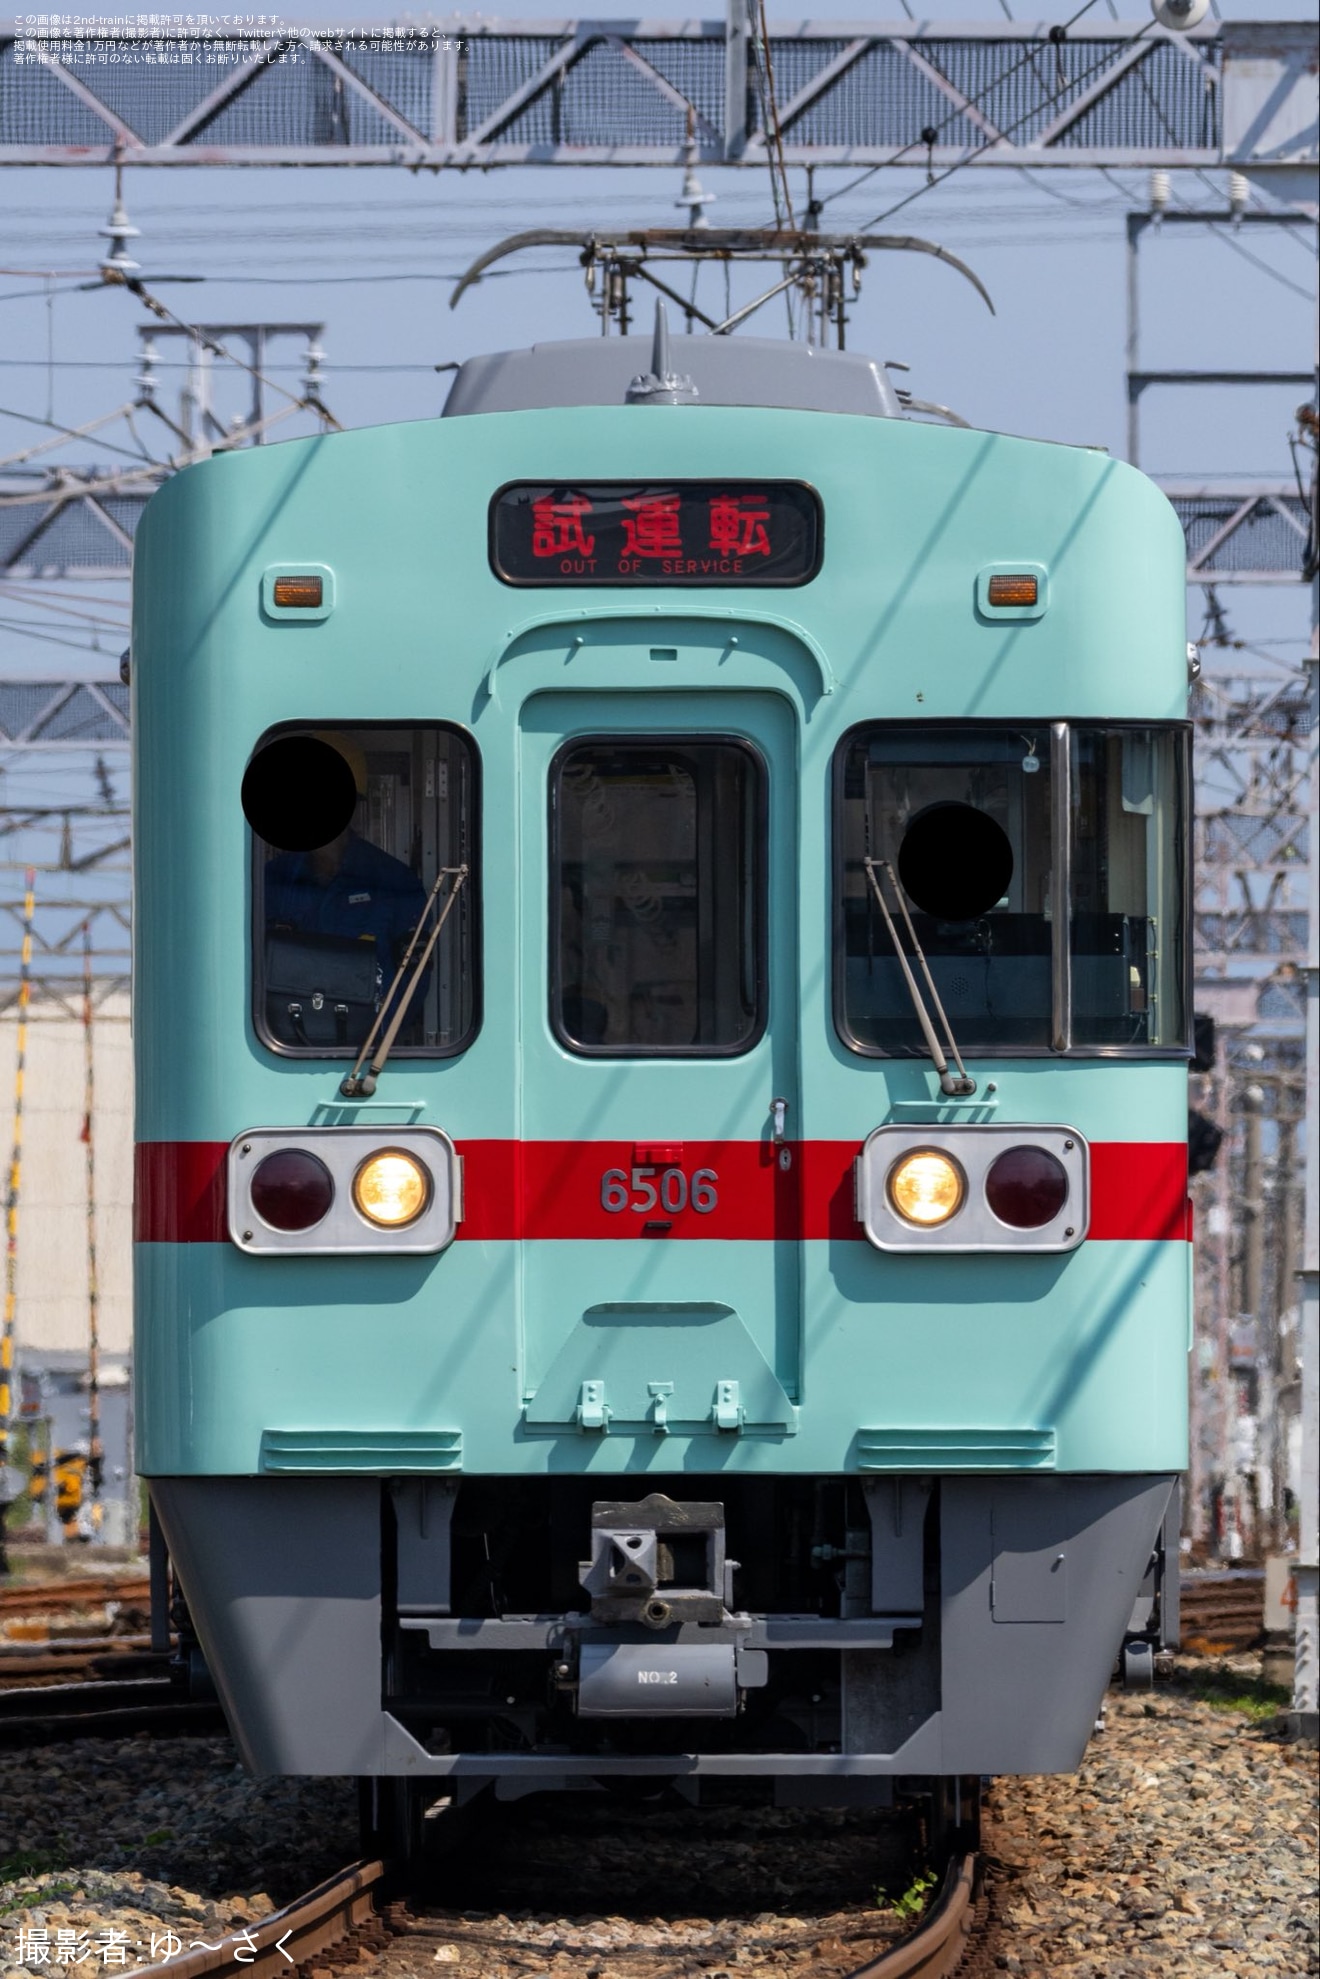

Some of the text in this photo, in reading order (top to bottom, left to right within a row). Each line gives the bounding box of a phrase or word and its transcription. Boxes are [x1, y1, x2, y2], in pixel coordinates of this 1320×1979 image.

[532, 494, 771, 558] 試運転
[560, 559, 743, 574] OUT OF SERVICE
[601, 1168, 718, 1213] 6506
[637, 1670, 678, 1685] NO.2
